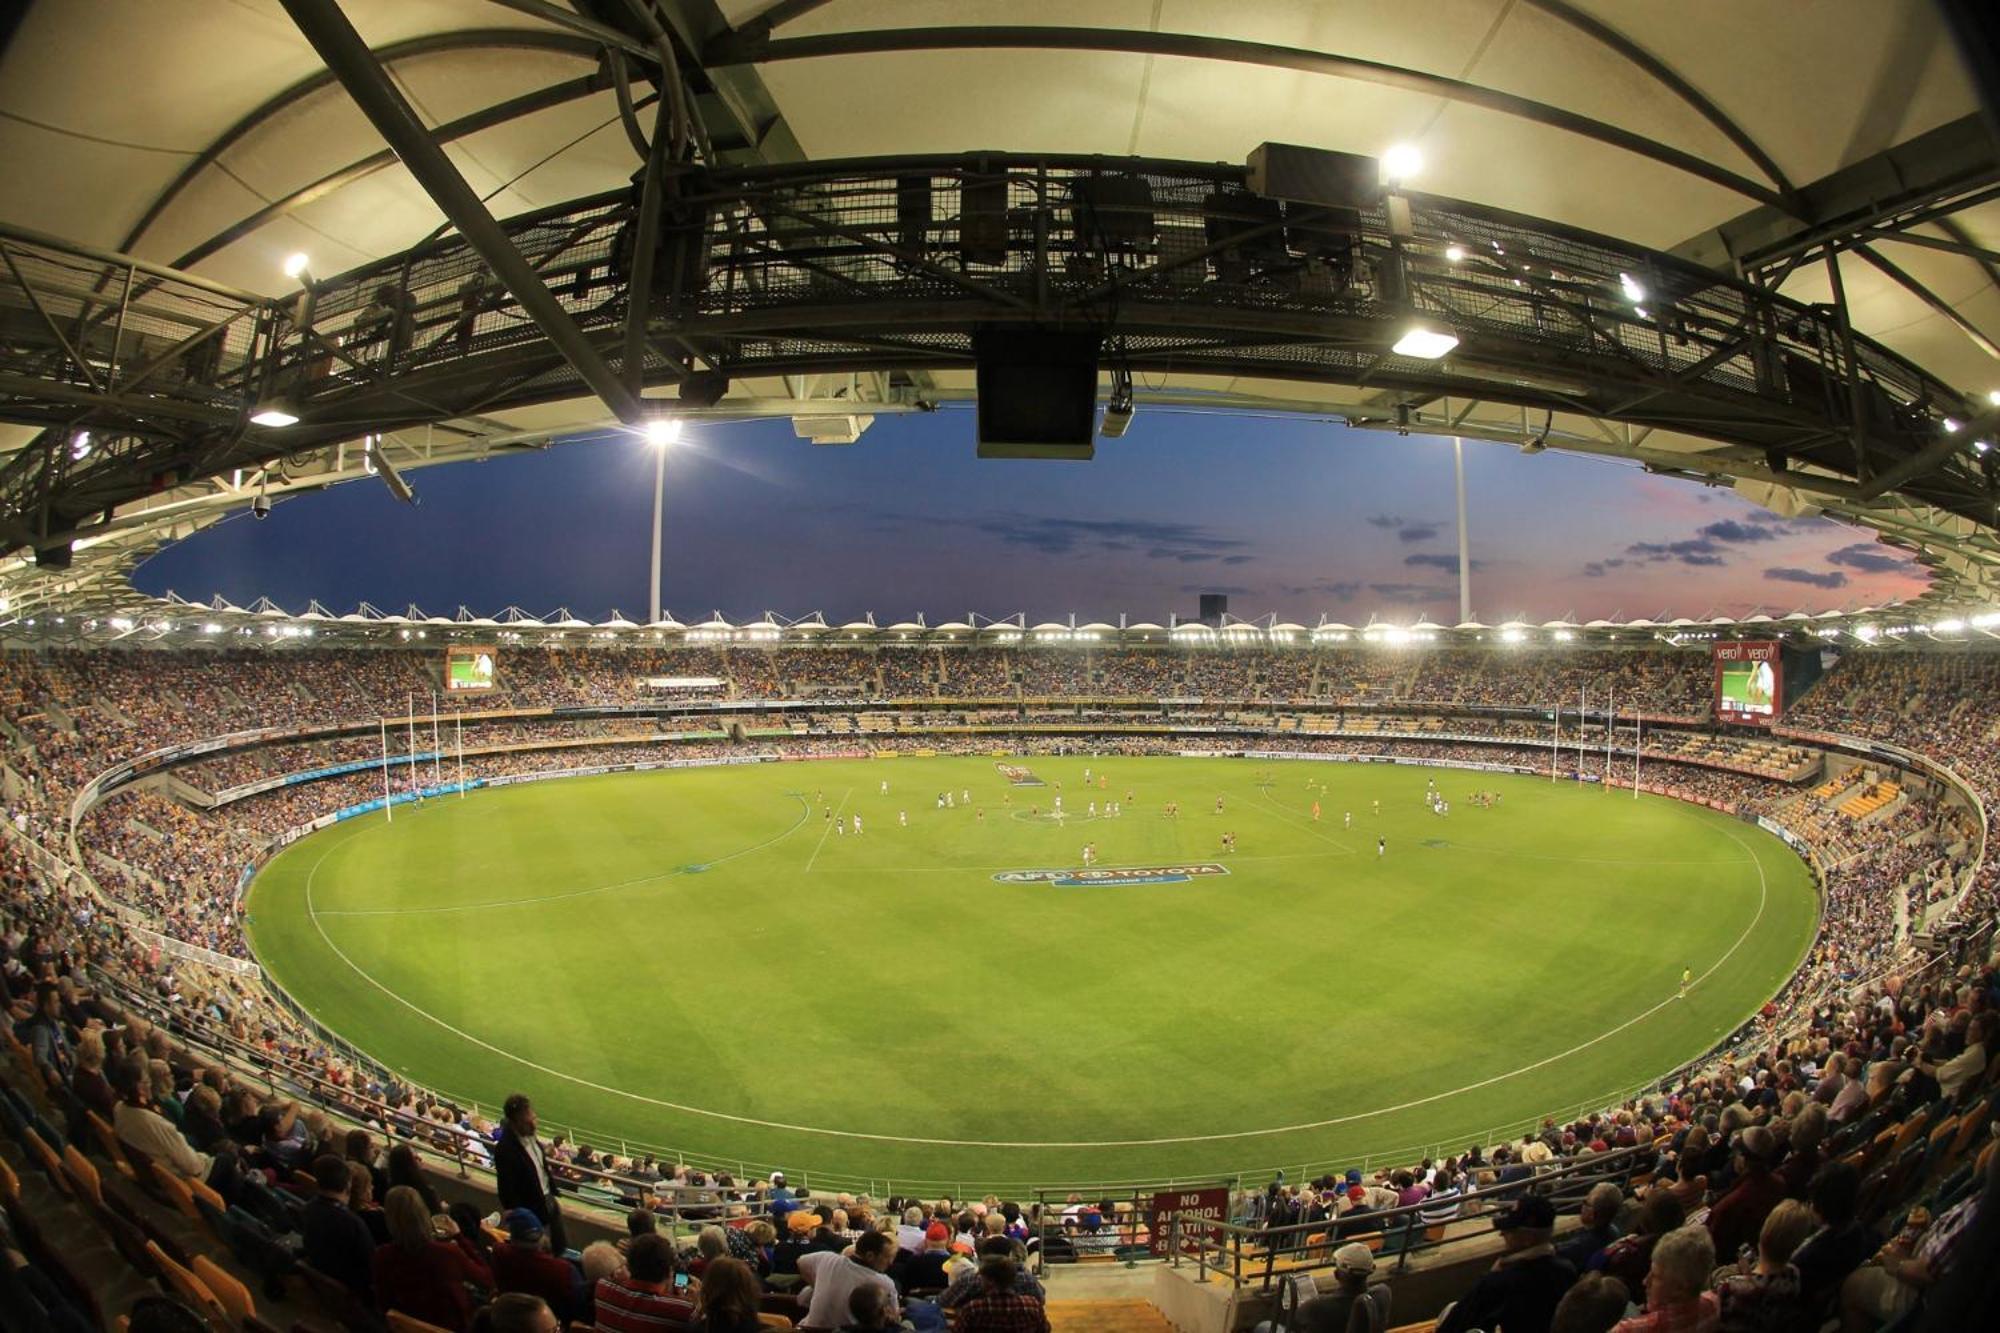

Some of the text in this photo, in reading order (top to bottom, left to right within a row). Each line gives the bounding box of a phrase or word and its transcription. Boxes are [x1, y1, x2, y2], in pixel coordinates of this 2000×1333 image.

[1716, 648, 1768, 660] vero vero
[1116, 866, 1219, 877] TOYOTA
[1180, 1194, 1200, 1206] NO
[1157, 1206, 1221, 1222] ALOHOL
